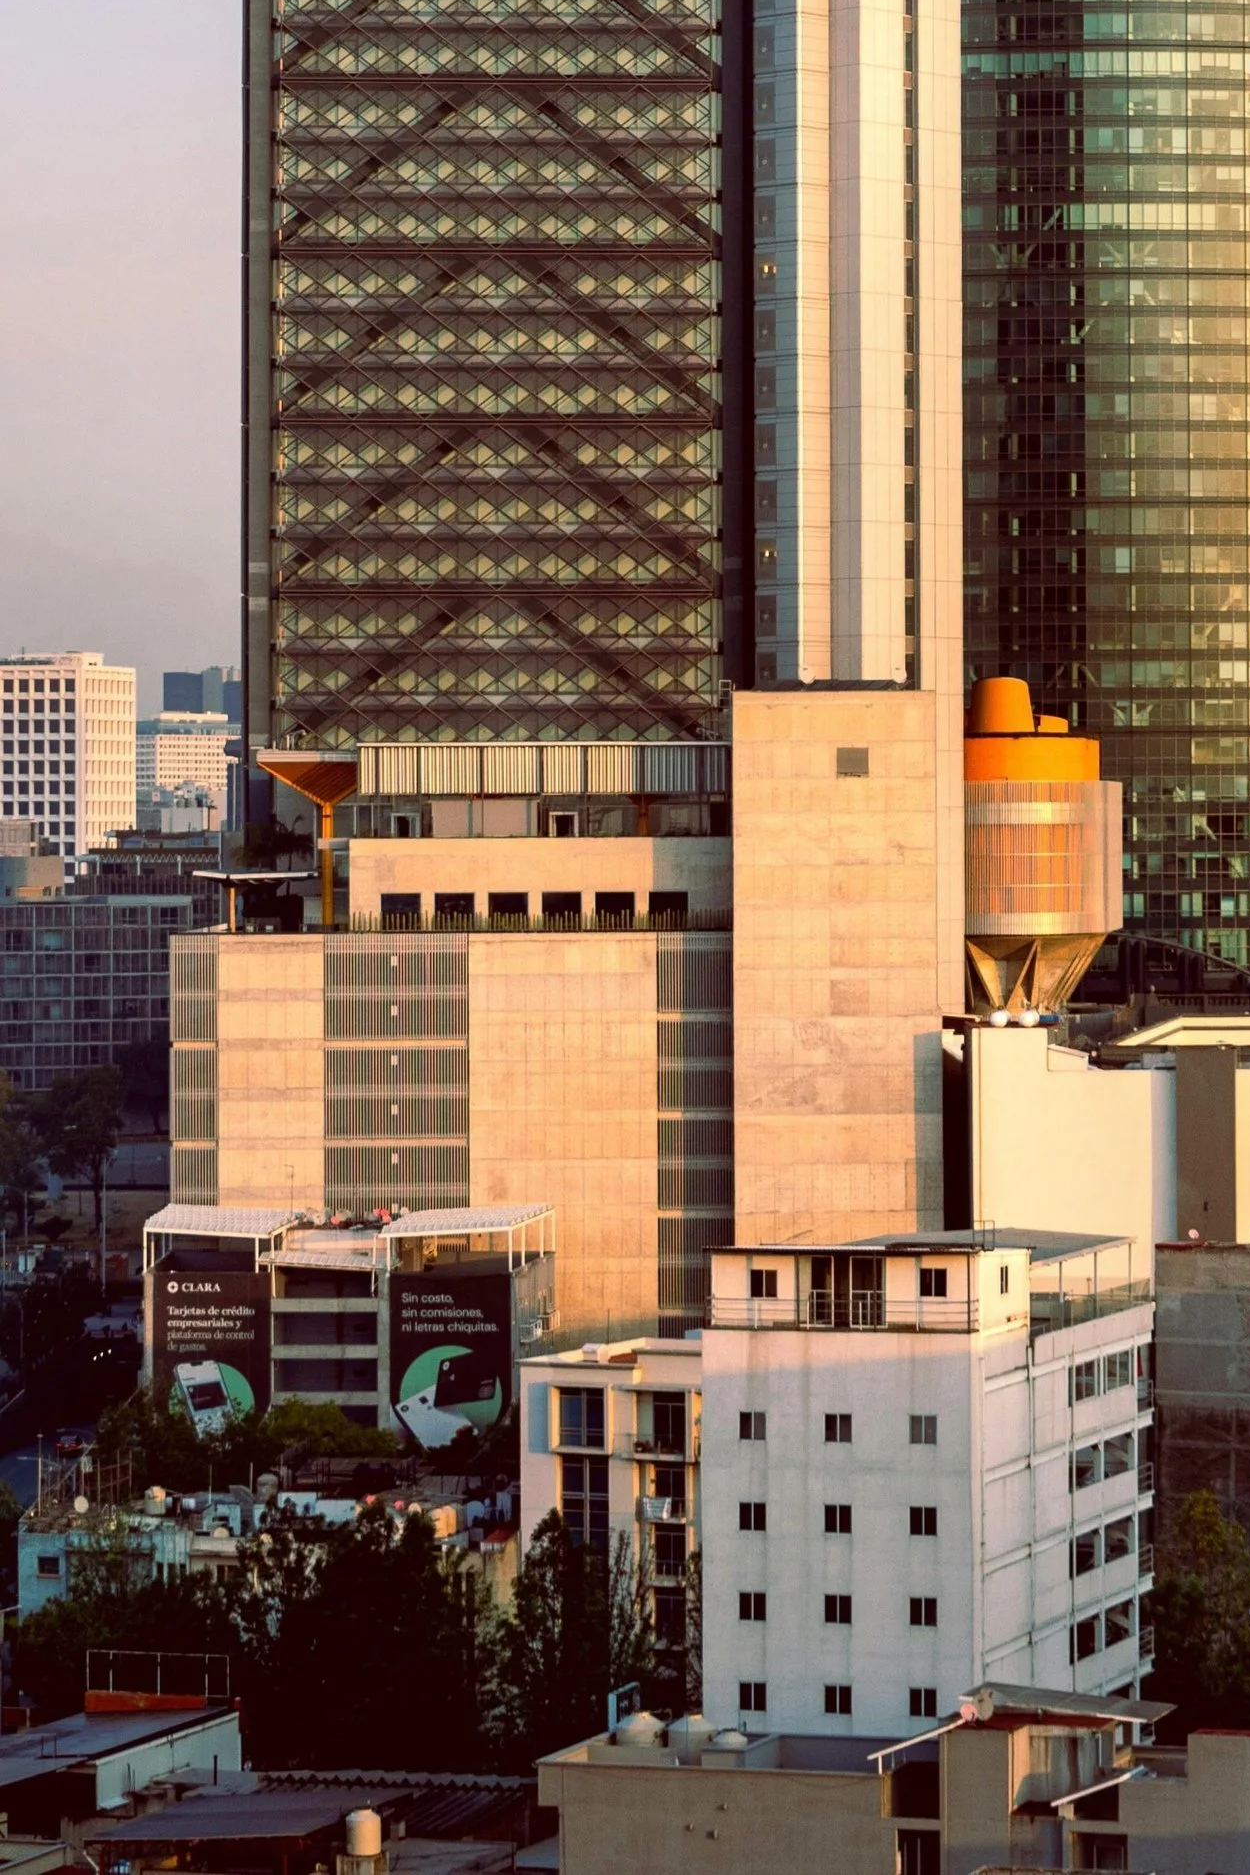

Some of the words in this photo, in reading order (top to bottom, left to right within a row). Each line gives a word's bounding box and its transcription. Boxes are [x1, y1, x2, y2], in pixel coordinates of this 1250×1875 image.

[181, 1282, 221, 1293] CLARA
[401, 1292, 419, 1303] Sin
[421, 1293, 454, 1305] costo,
[167, 1305, 206, 1317] Tarjetas
[207, 1305, 220, 1315] de
[221, 1305, 255, 1316] crédito
[401, 1306, 417, 1318] sin
[420, 1306, 483, 1319] comisiones,
[167, 1317, 234, 1329] empresariales
[235, 1319, 242, 1329] y
[401, 1321, 412, 1332] ni
[414, 1321, 445, 1332] letras
[447, 1321, 500, 1334] chiquitas.
[167, 1329, 212, 1341] plataforma
[213, 1329, 224, 1339] de
[225, 1329, 255, 1339] control
[167, 1341, 177, 1351] de
